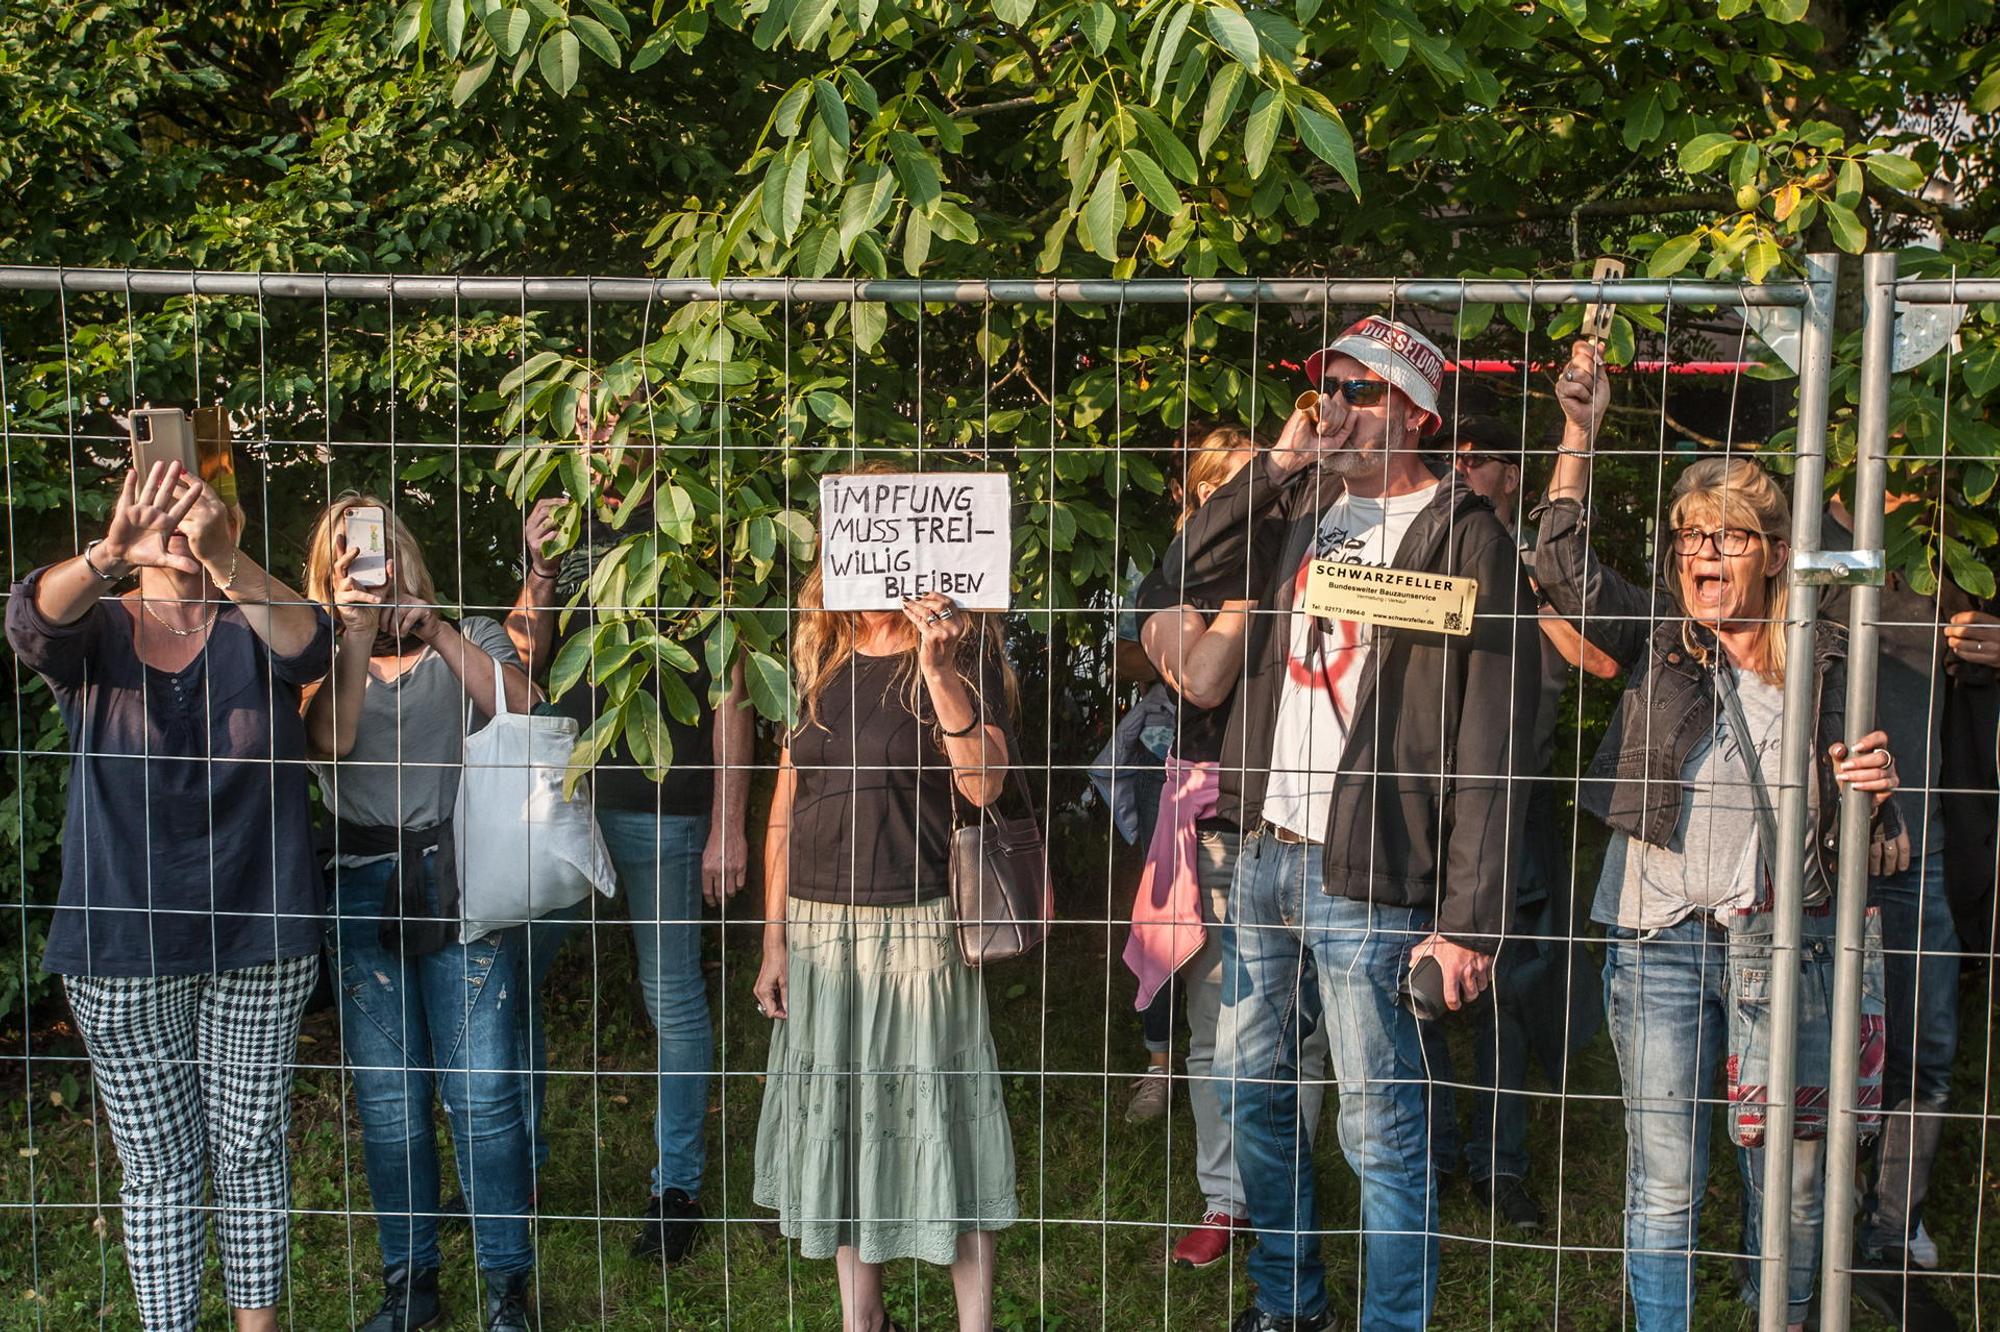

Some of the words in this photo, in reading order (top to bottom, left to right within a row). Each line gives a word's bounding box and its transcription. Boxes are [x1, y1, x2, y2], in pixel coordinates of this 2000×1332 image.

[833, 481, 974, 514] IMPFUNG
[830, 518, 902, 543] MUSS
[830, 548, 911, 576] WILLIG
[884, 570, 985, 598] BLEIBEN
[1316, 565, 1454, 592] SCHWARZFELLER
[1328, 581, 1378, 595] Bundesweiter
[1379, 588, 1437, 602] Bauzaunservice
[1324, 605, 1342, 613] 02173
[1373, 613, 1434, 625] www.schwarzfeller.de
